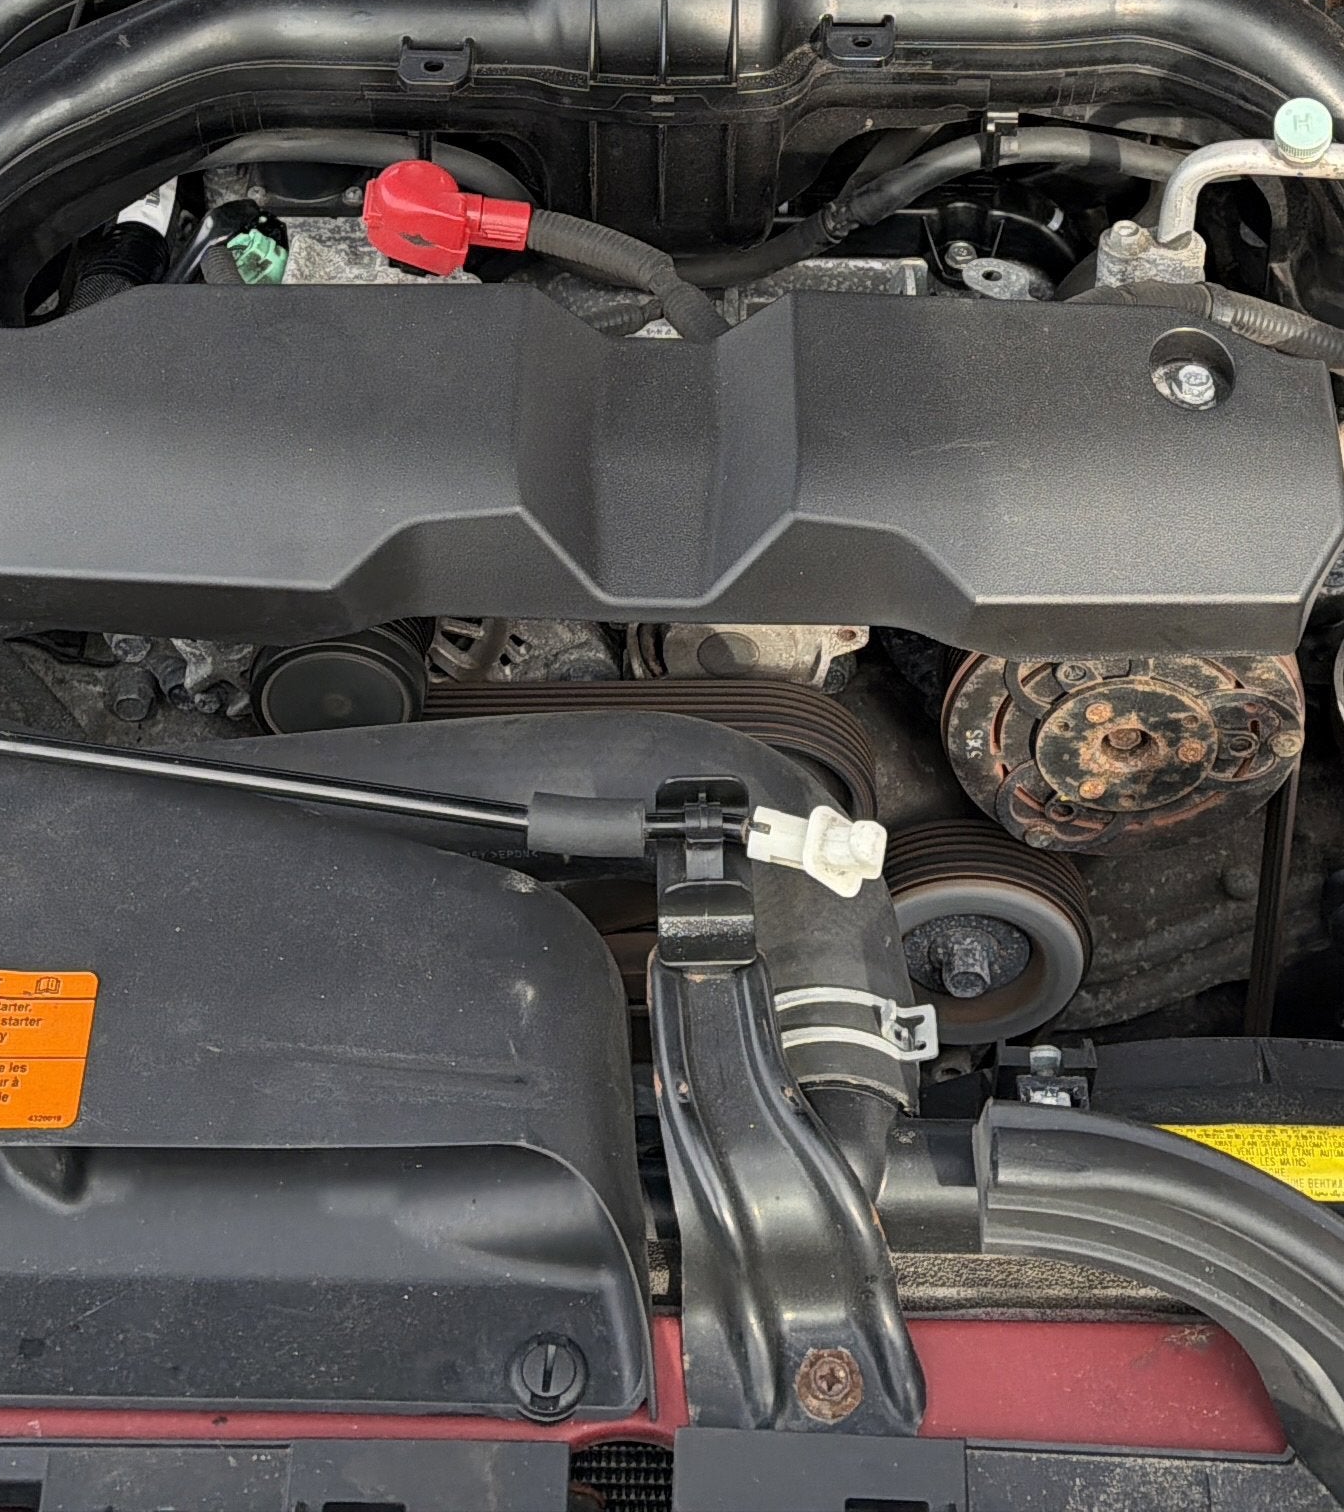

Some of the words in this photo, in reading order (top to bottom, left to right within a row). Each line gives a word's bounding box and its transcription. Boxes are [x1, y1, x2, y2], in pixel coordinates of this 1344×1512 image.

[1, 1016, 43, 1027] starter
[8, 1061, 28, 1074] les
[1236, 1147, 1288, 1157] VENTILATEUR
[1260, 1158, 1276, 1166] LES
